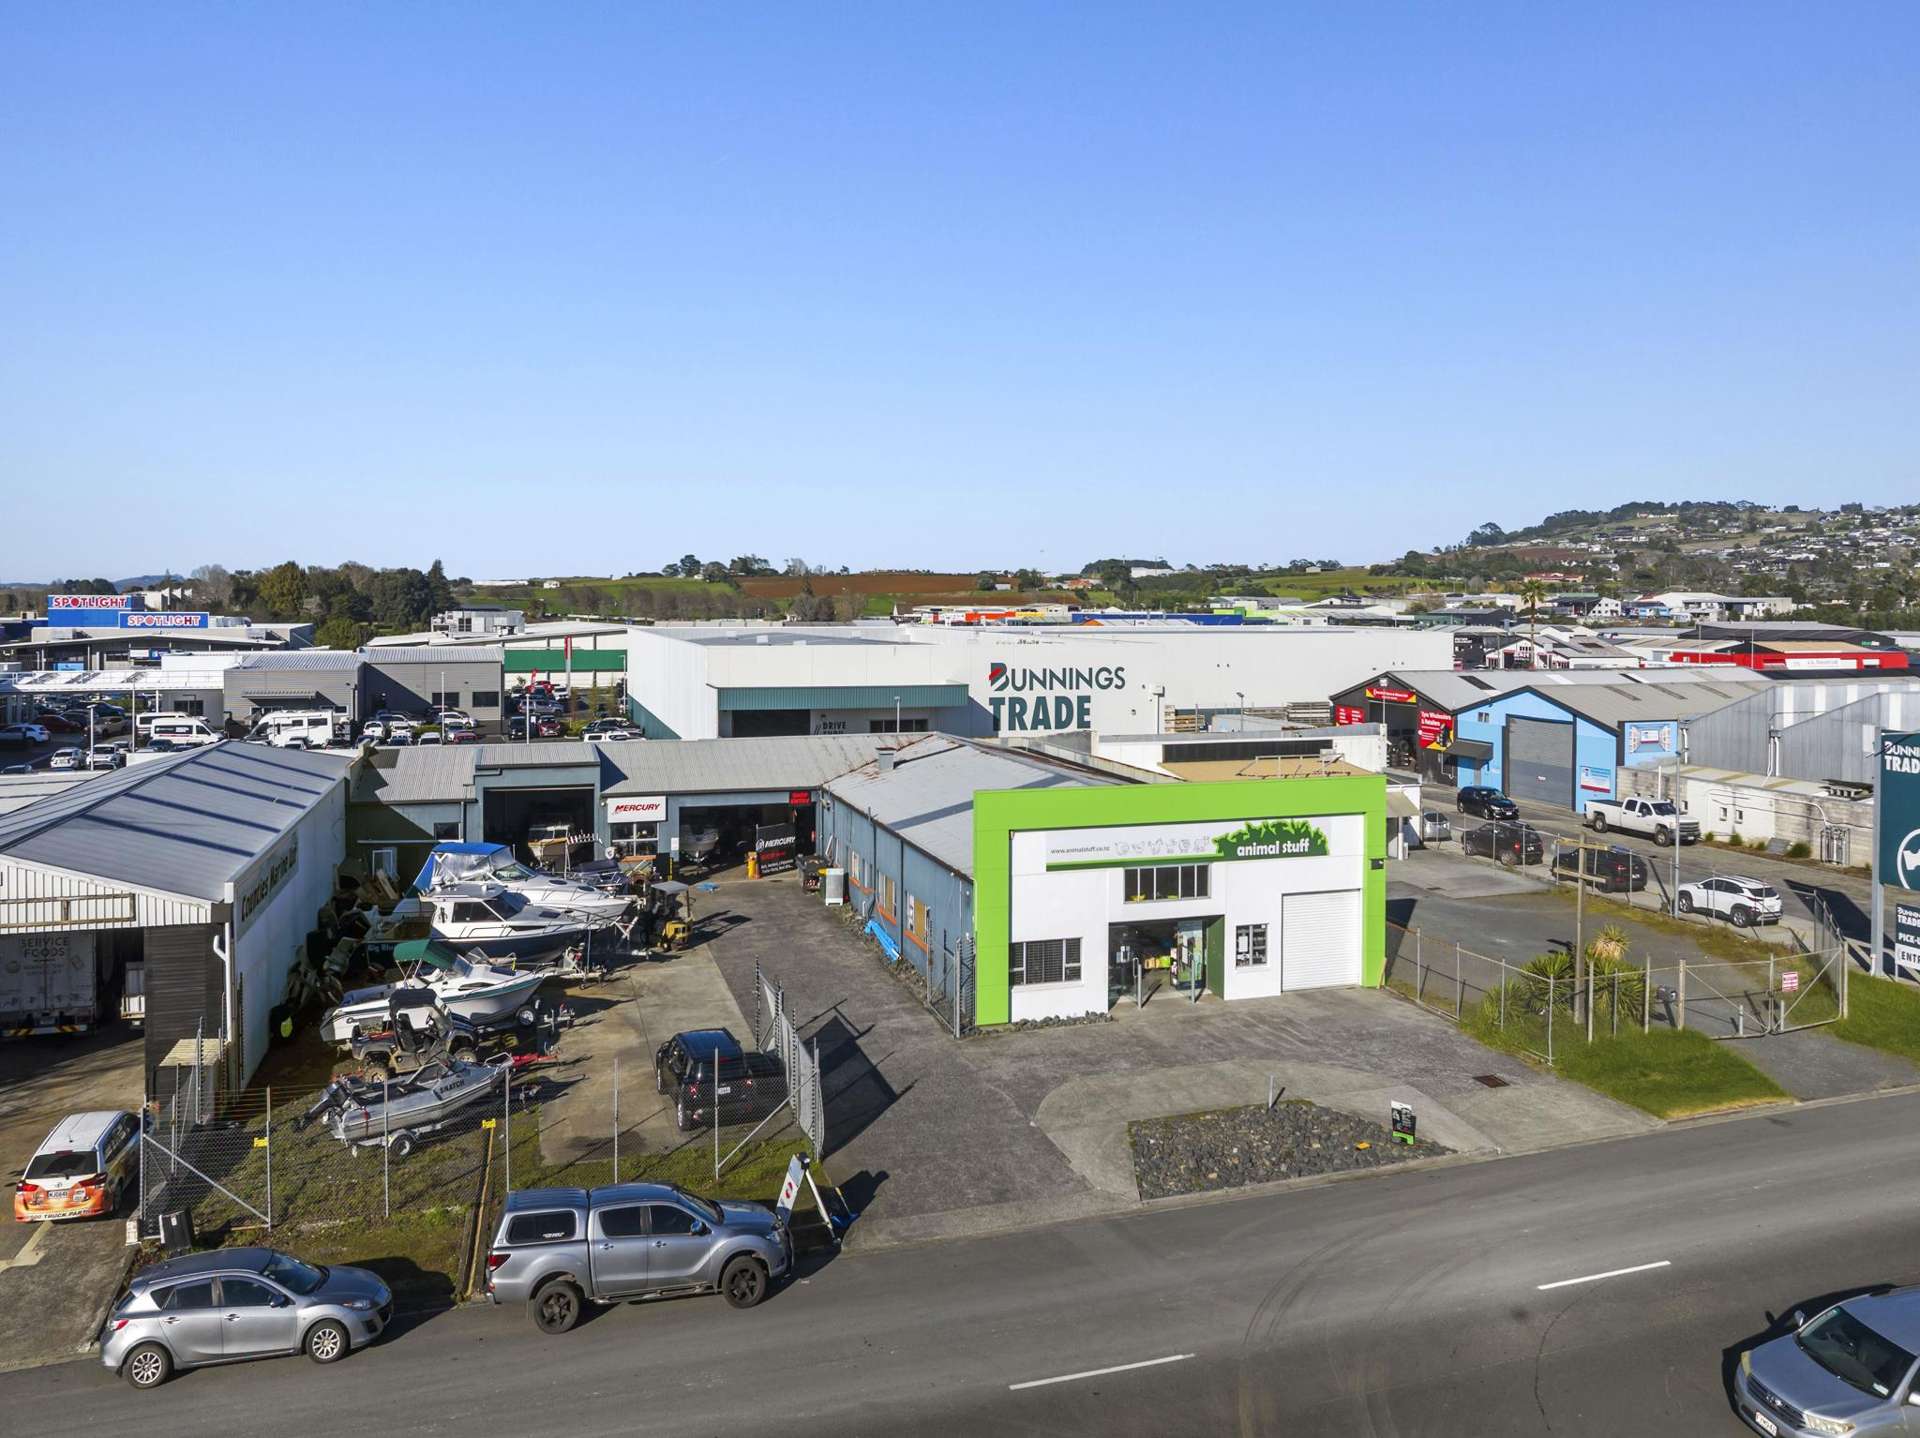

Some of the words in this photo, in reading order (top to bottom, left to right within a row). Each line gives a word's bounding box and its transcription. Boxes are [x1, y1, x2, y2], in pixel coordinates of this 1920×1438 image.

[54, 597, 126, 607] SPOTLIGHT
[128, 615, 200, 625] SPOTLIGHT
[988, 662, 1126, 691] BUNNINGS
[988, 695, 1091, 731] TRADE
[822, 721, 846, 730] DRIVE
[614, 803, 661, 812] MERCURY
[765, 836, 796, 848] MERCURY
[1236, 841, 1280, 857] animal
[1282, 838, 1310, 854] stuff
[21, 936, 70, 948] SERVICE
